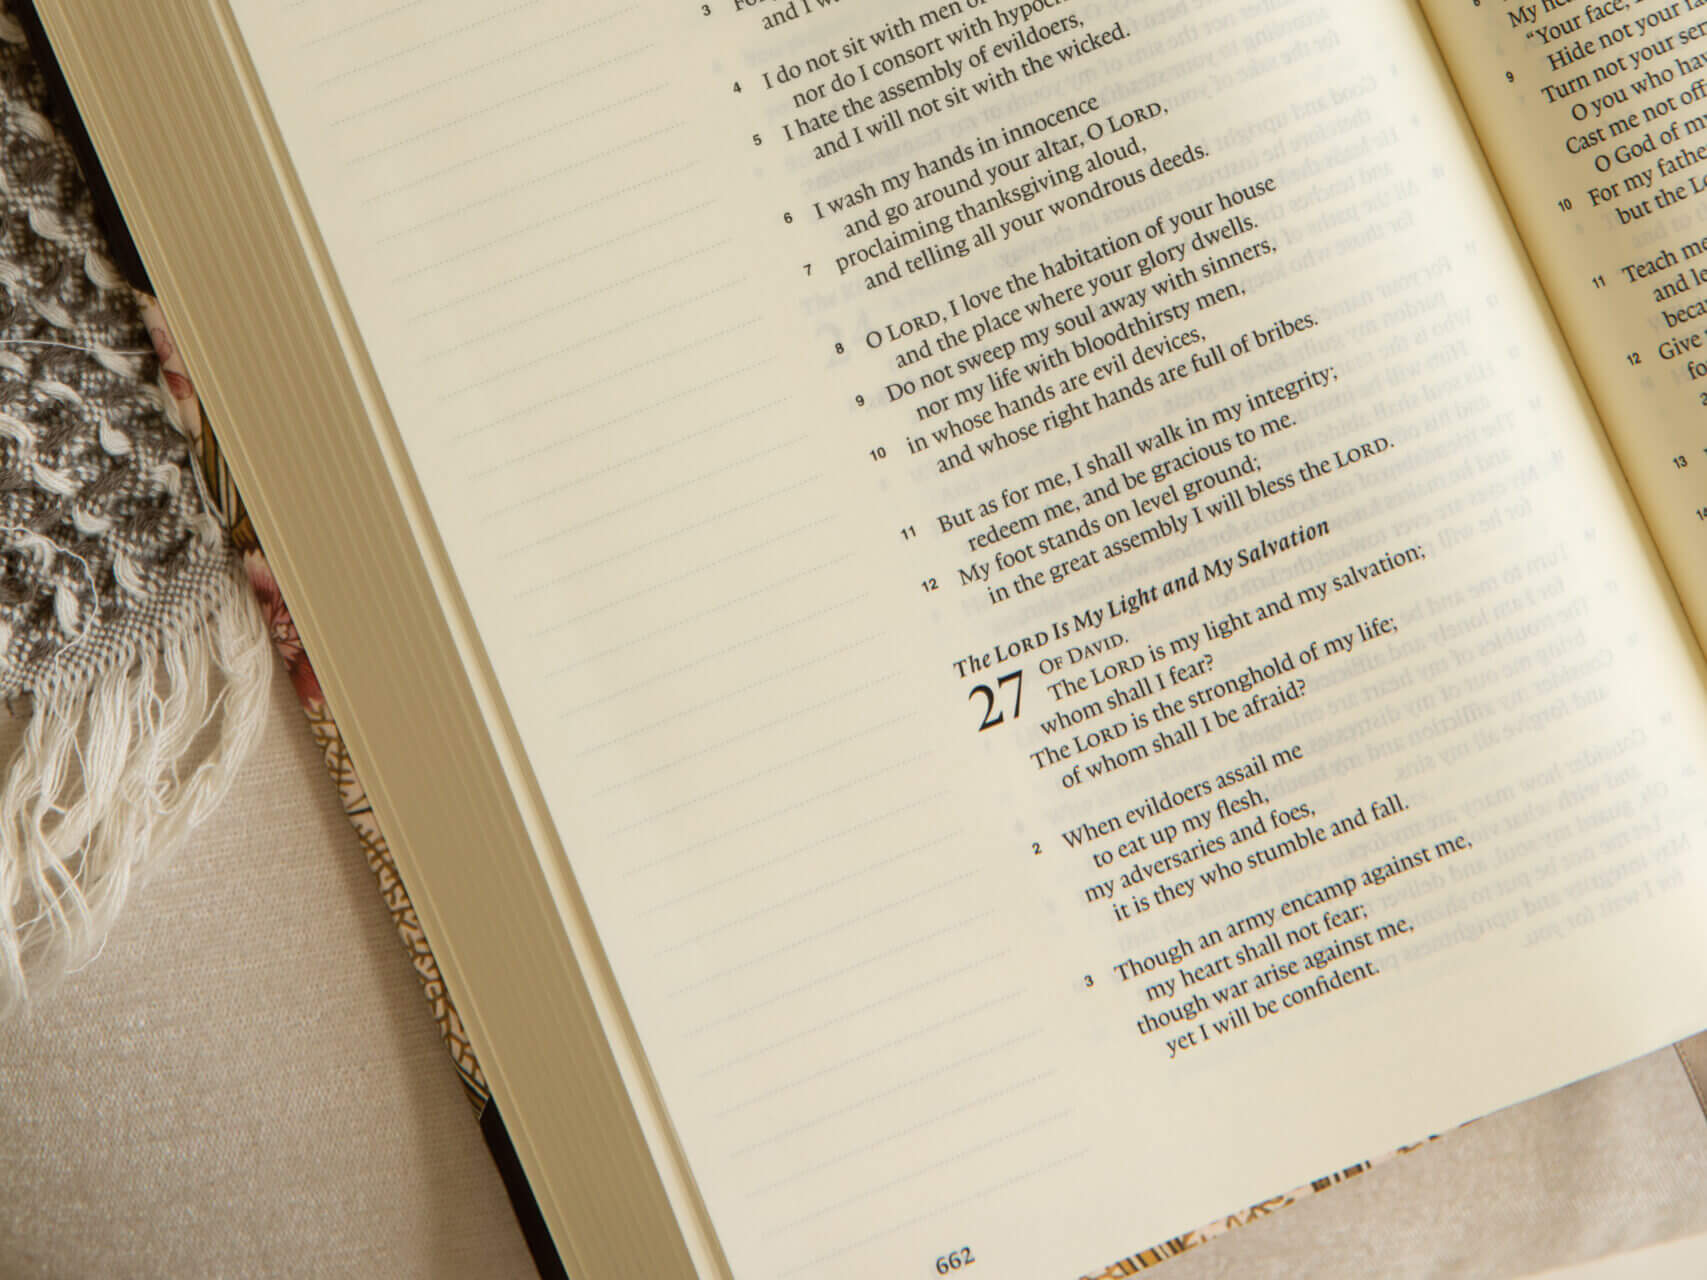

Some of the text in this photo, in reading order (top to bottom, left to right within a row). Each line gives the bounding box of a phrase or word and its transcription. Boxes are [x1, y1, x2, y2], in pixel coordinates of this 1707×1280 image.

[733, 81, 742, 94] 4
[762, 72, 773, 90] I
[776, 64, 802, 84] do
[805, 48, 840, 73] not
[842, 37, 868, 59] sit
[869, 17, 916, 46] with
[918, 1, 963, 28] men
[761, 0, 800, 30] and
[1506, 4, 1537, 28] My
[783, 97, 1100, 224] 6 I wash my hands in innocence
[835, 135, 1147, 276] proclaiming thanksgiving aloud,
[865, 178, 1277, 349] O LORD, I love the habitation of your house
[921, 454, 1262, 593] 12 My foot stands on level ground;
[952, 520, 1330, 678] The LORD Is My Light and My Salvation
[967, 670, 1024, 733] 27
[1039, 653, 1214, 735] whom shall I fear?
[1031, 745, 1303, 856] 2 When evildoers assail me
[1112, 793, 1409, 922] it is they who stumble and fall.
[1166, 962, 1380, 1059] yet I will be confident.
[935, 1246, 976, 1275] 662
